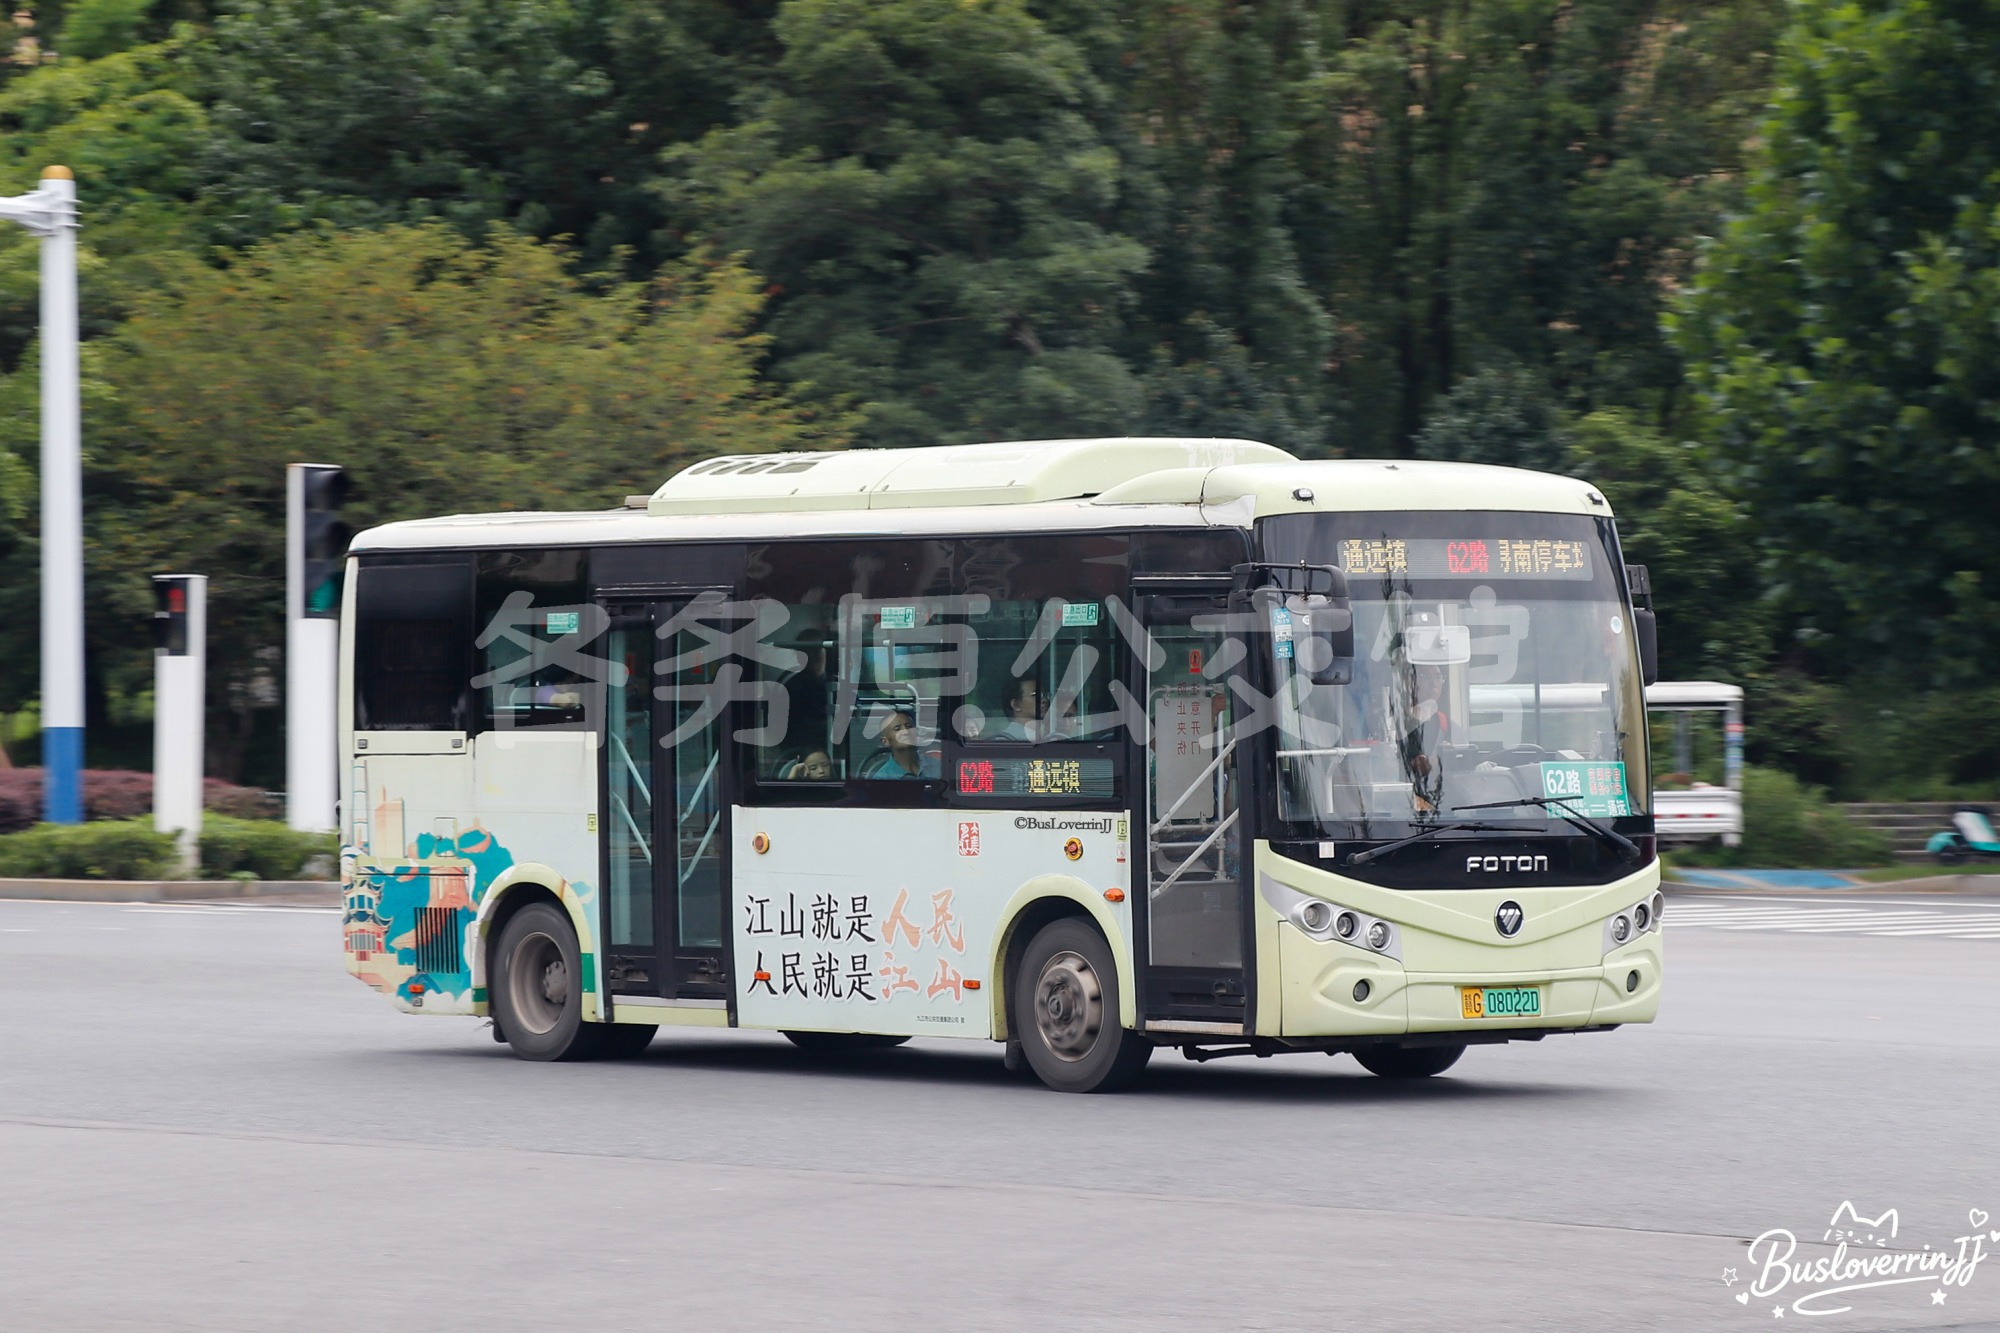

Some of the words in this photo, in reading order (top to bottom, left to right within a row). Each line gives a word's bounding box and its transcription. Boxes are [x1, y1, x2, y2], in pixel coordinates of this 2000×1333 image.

[1343, 539, 1408, 574] 通远镇
[1447, 539, 1489, 573] 62路
[959, 760, 995, 793] 62路
[1028, 760, 1080, 793] 通远镇
[1546, 769, 1582, 794] 62路
[1466, 855, 1549, 873] FOTON
[744, 888, 965, 952] 江山就是人民
[746, 949, 962, 1002] 人民就是江山
